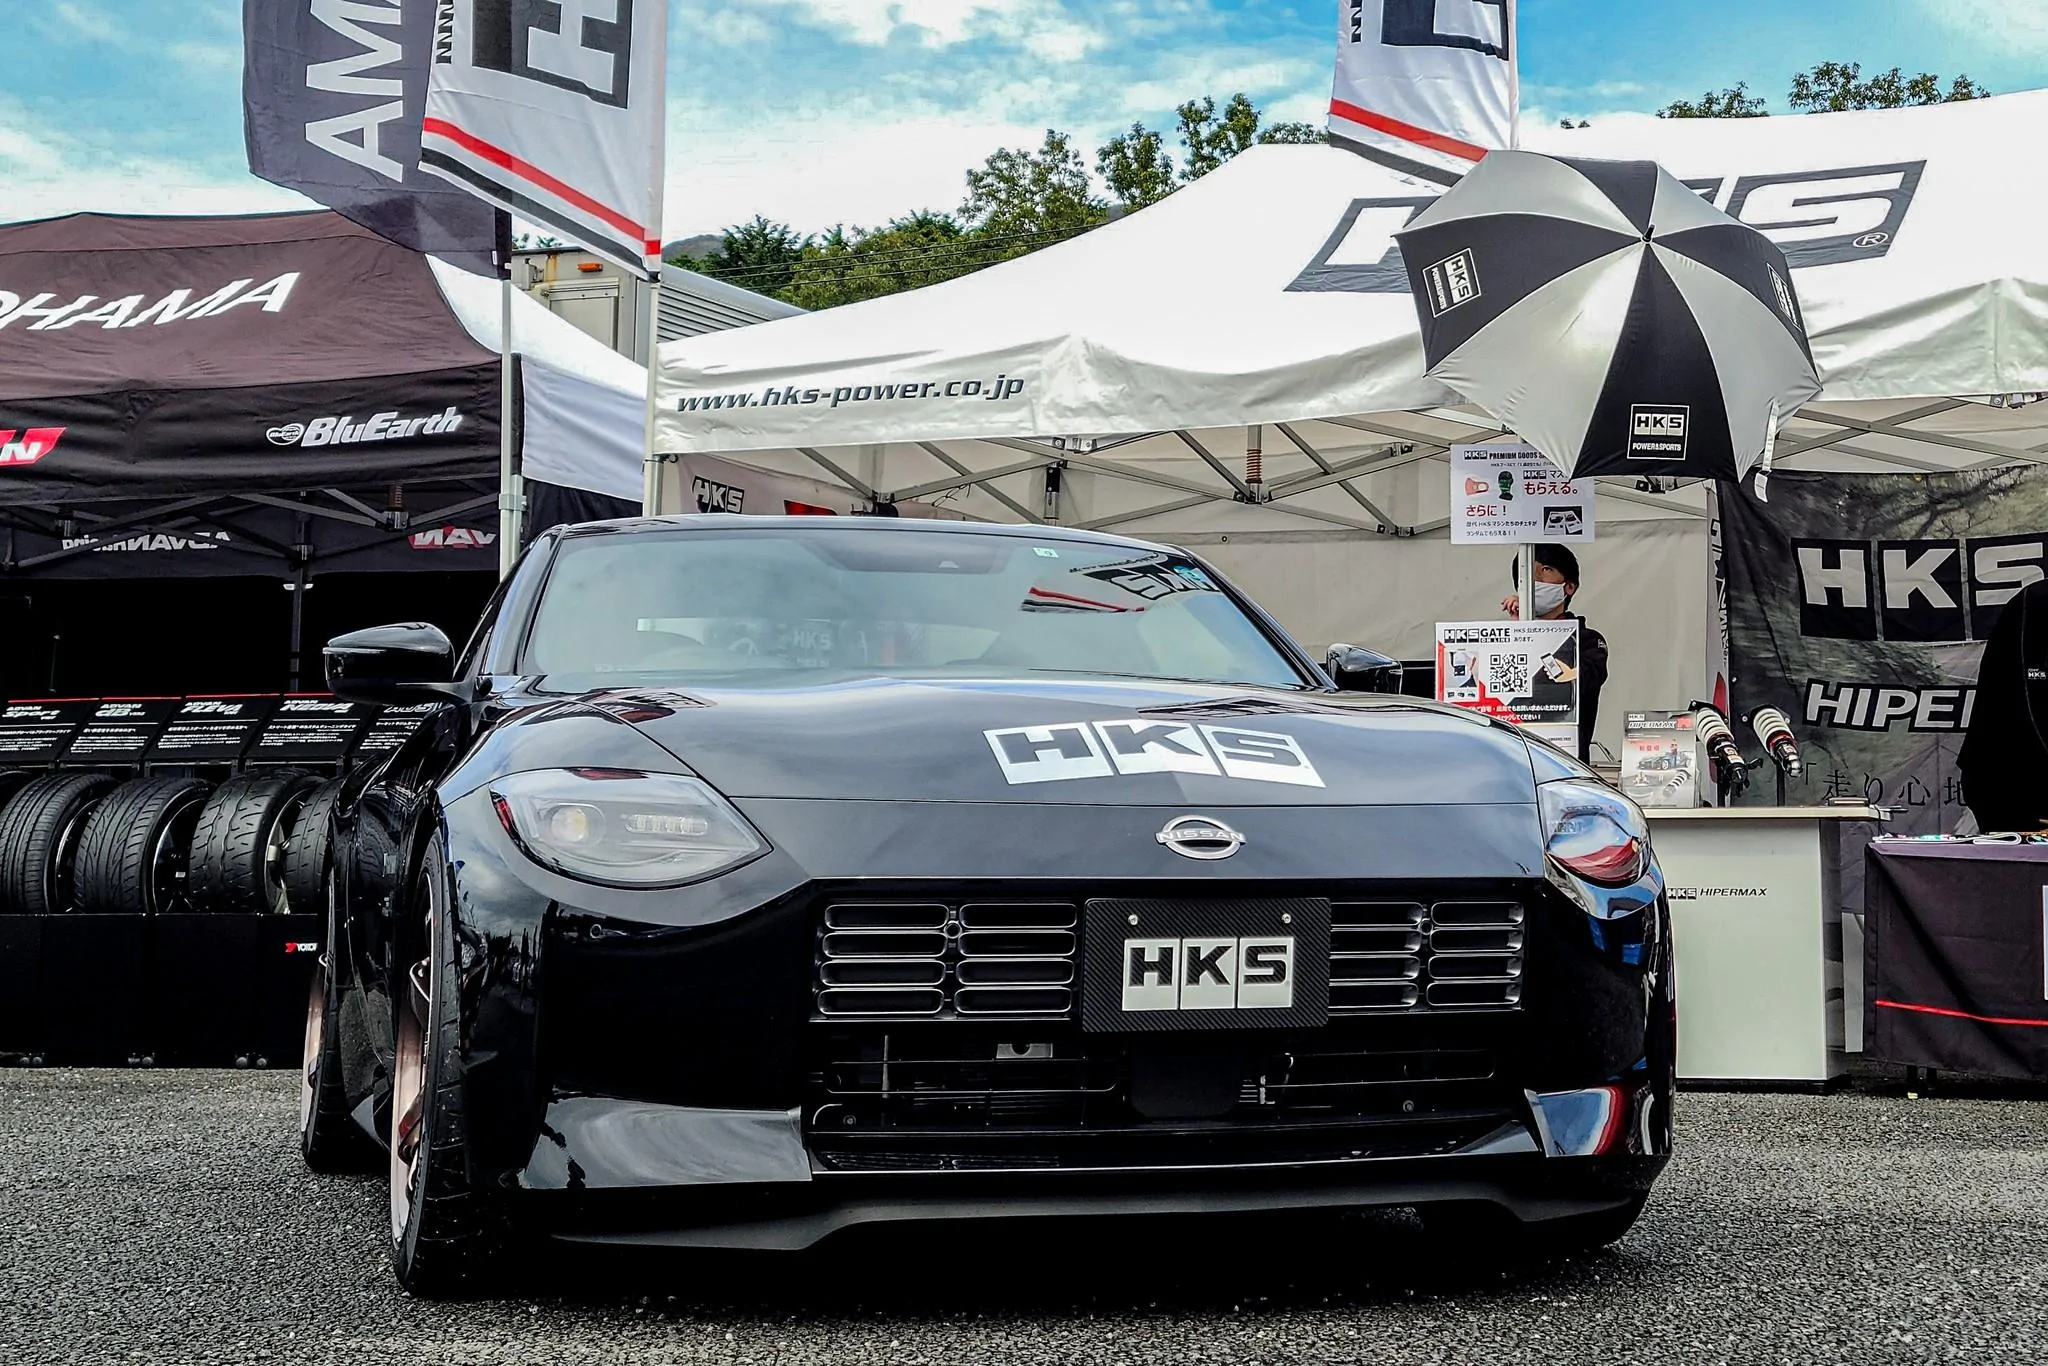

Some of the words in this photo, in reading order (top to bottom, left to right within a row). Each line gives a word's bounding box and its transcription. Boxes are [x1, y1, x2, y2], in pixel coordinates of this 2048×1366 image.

[1448, 257, 1472, 301] HKS
[677, 374, 1025, 412] www.hks-power.co.jp
[301, 407, 462, 446] BluEarth
[1635, 414, 1684, 432] HKS
[1464, 451, 1487, 459] HKS
[1489, 452, 1516, 460] PREMIUM
[1632, 442, 1682, 451] POWER&SPORTS
[1523, 470, 1547, 479] HKS
[1549, 470, 1568, 479] マス
[693, 477, 744, 513] HKS
[1524, 482, 1578, 495] もらえる。
[1796, 540, 2046, 618] HKS
[1444, 629, 1479, 642] HKS
[1480, 628, 1510, 637] GATE
[1807, 684, 1976, 728] HIPE
[989, 721, 1318, 776] HKS
[1159, 830, 1242, 841] NISSAN
[1667, 888, 1697, 899] HKS
[1700, 888, 1767, 896] HIPERMAX
[1125, 940, 1291, 998] HKS
